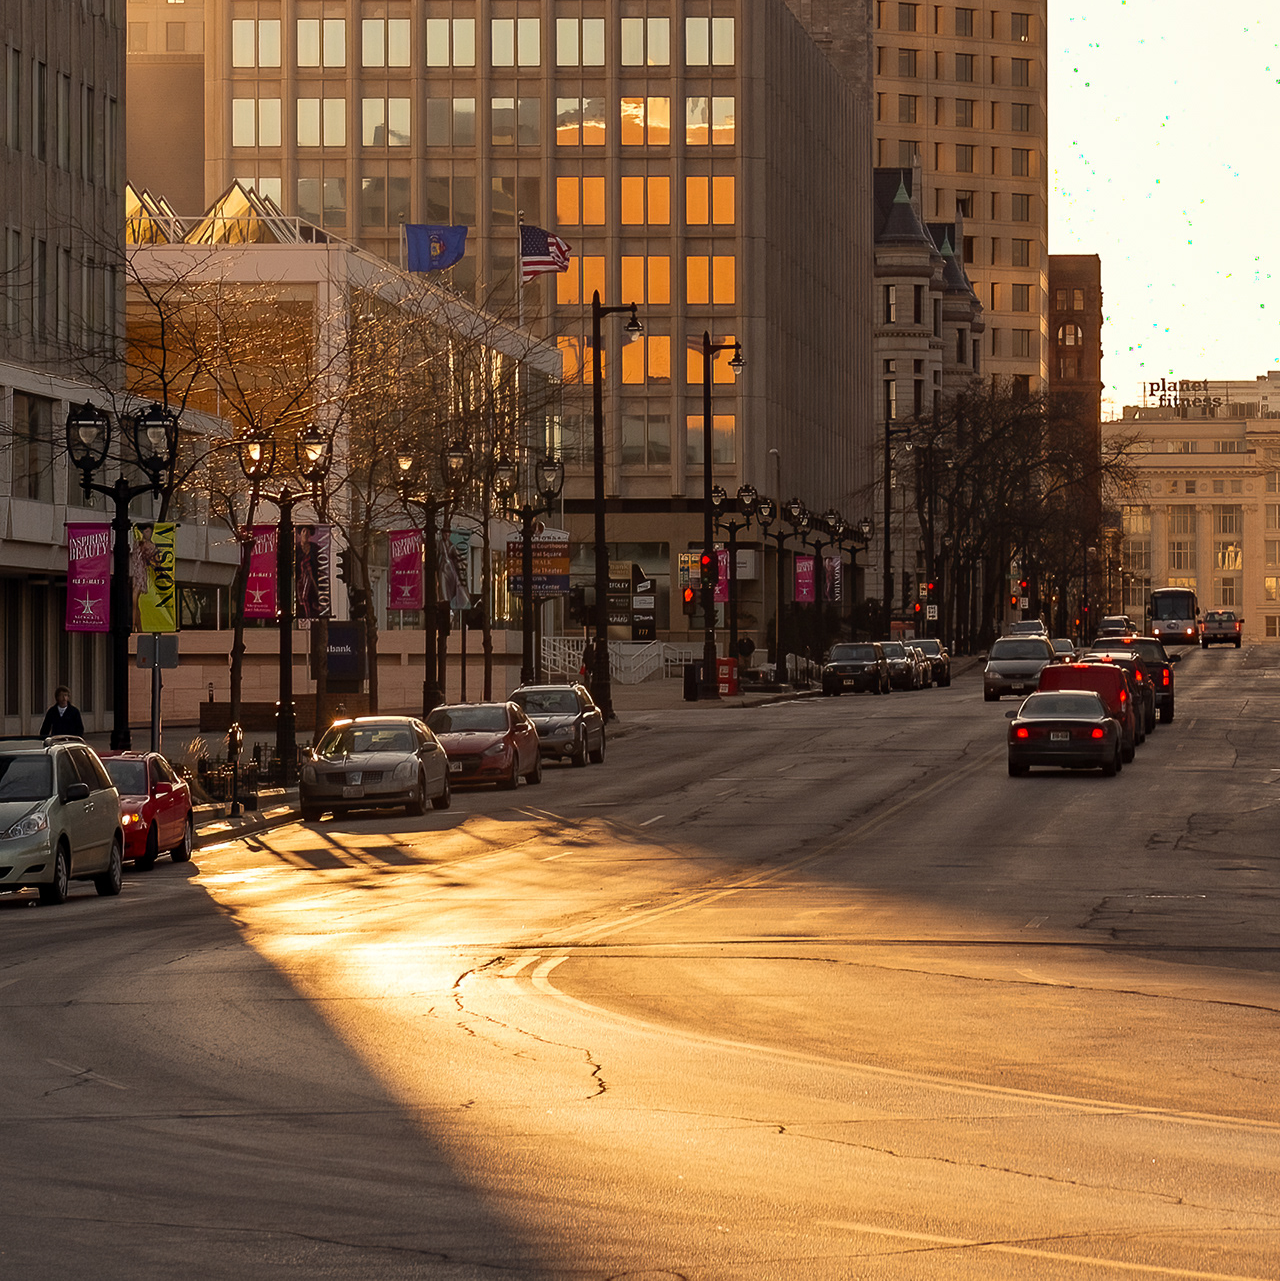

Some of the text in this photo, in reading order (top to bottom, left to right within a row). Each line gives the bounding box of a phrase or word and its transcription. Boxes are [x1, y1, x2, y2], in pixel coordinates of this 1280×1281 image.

[1148, 378, 1209, 397] planet
[1158, 394, 1222, 408] fitness
[69, 532, 109, 549] INSPIRING
[69, 543, 107, 561] BEAUTY
[155, 526, 174, 609] VISION
